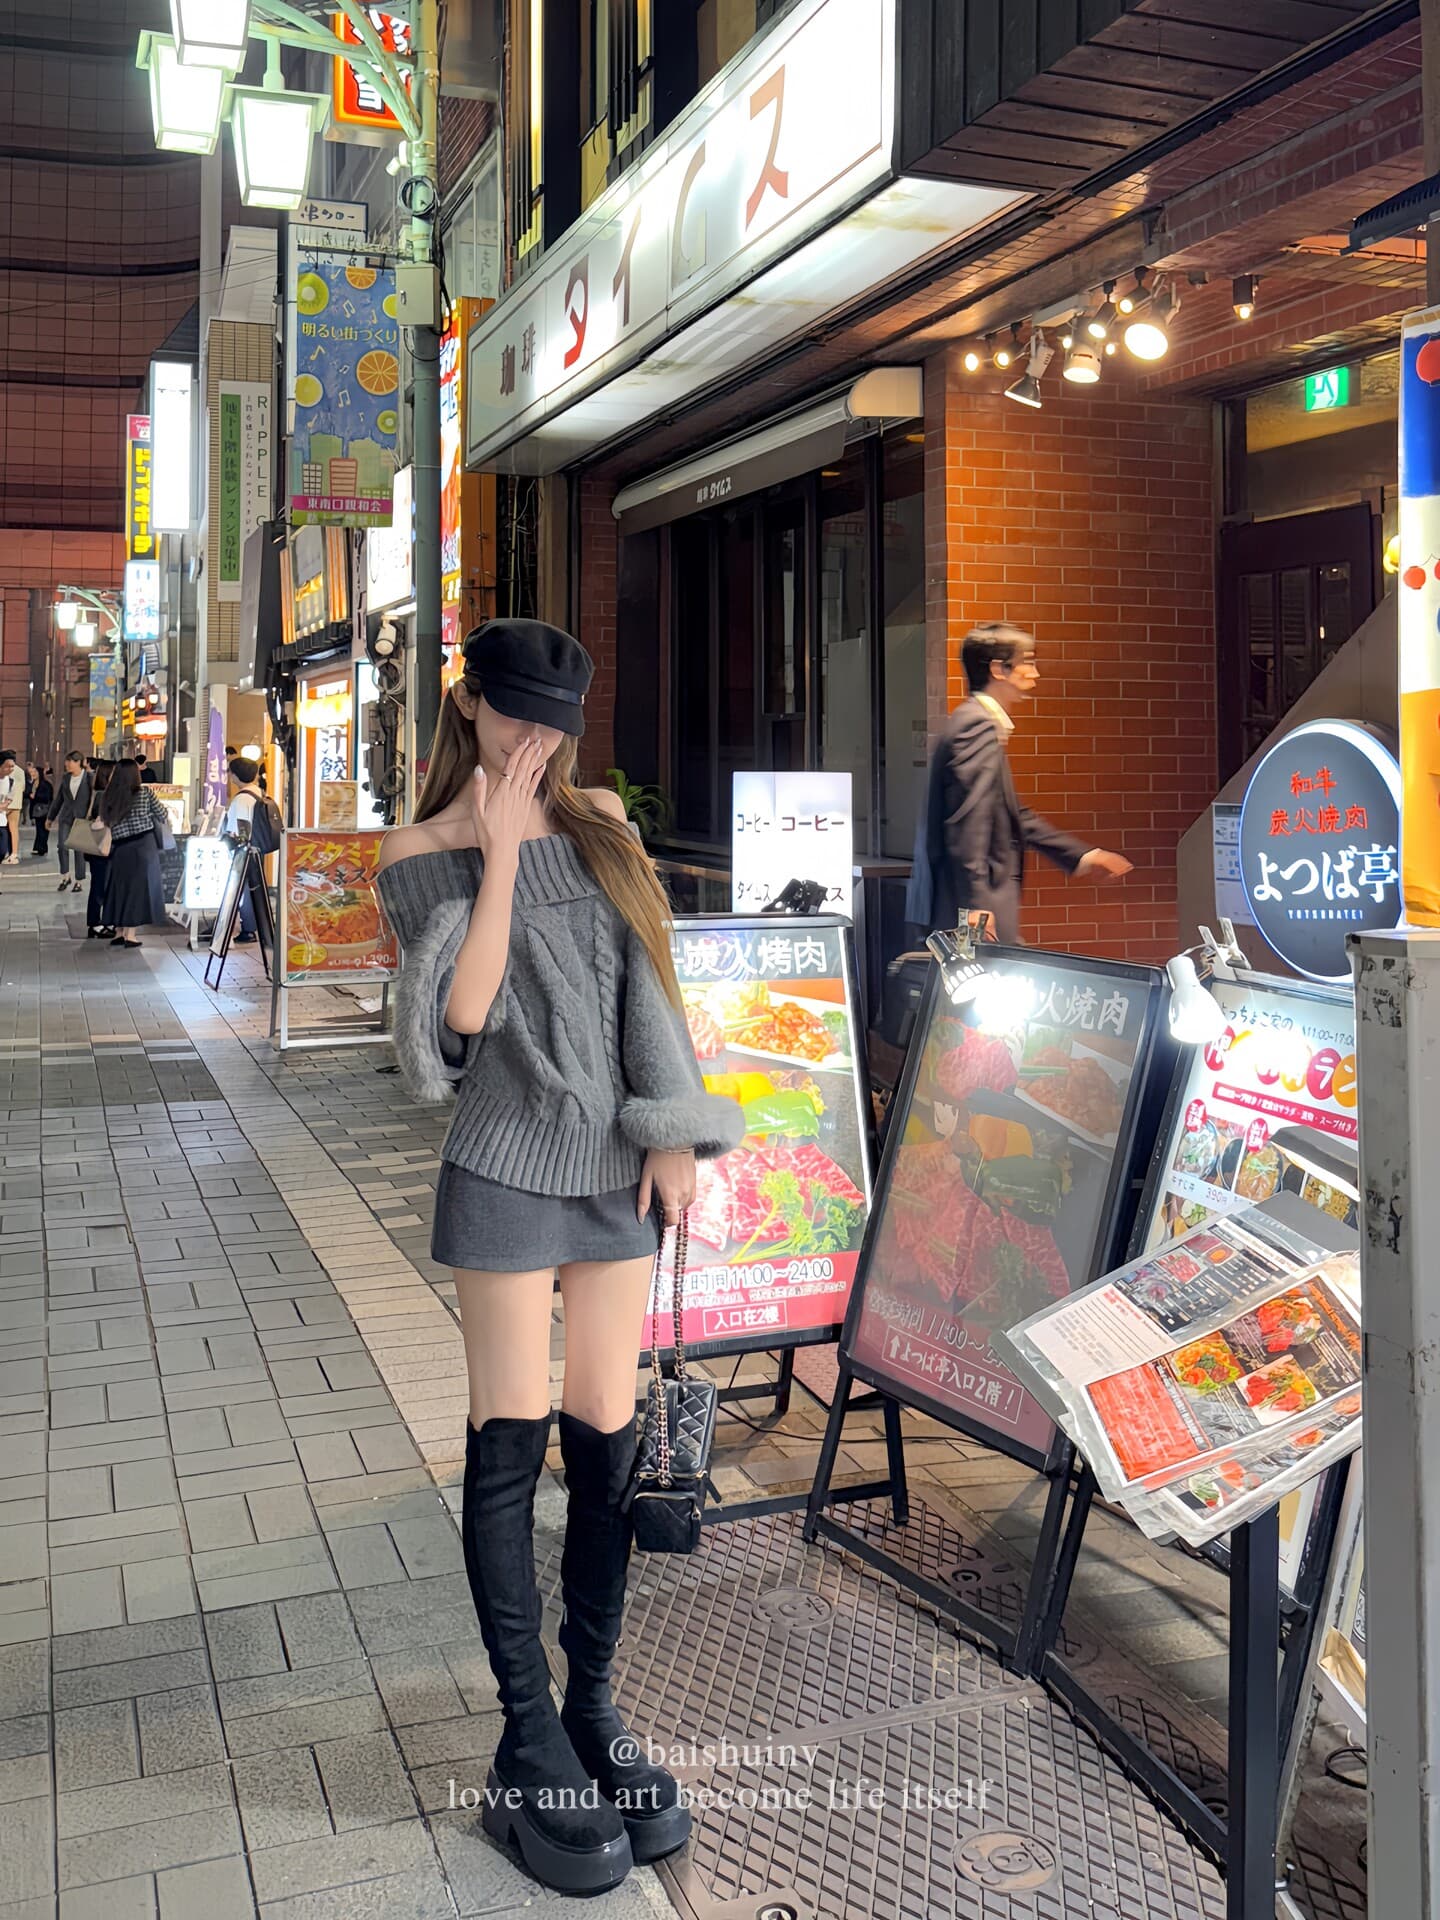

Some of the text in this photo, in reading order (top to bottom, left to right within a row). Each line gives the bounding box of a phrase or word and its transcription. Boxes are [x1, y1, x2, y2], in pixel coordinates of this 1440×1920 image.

[256, 395, 268, 499] RIPPLE
[1289, 766, 1338, 799] 和牛
[737, 813, 770, 833] コーヒー
[781, 814, 845, 832] コーヒー
[1267, 803, 1369, 837] 炭火焼肉
[1253, 843, 1400, 903] よつば亭
